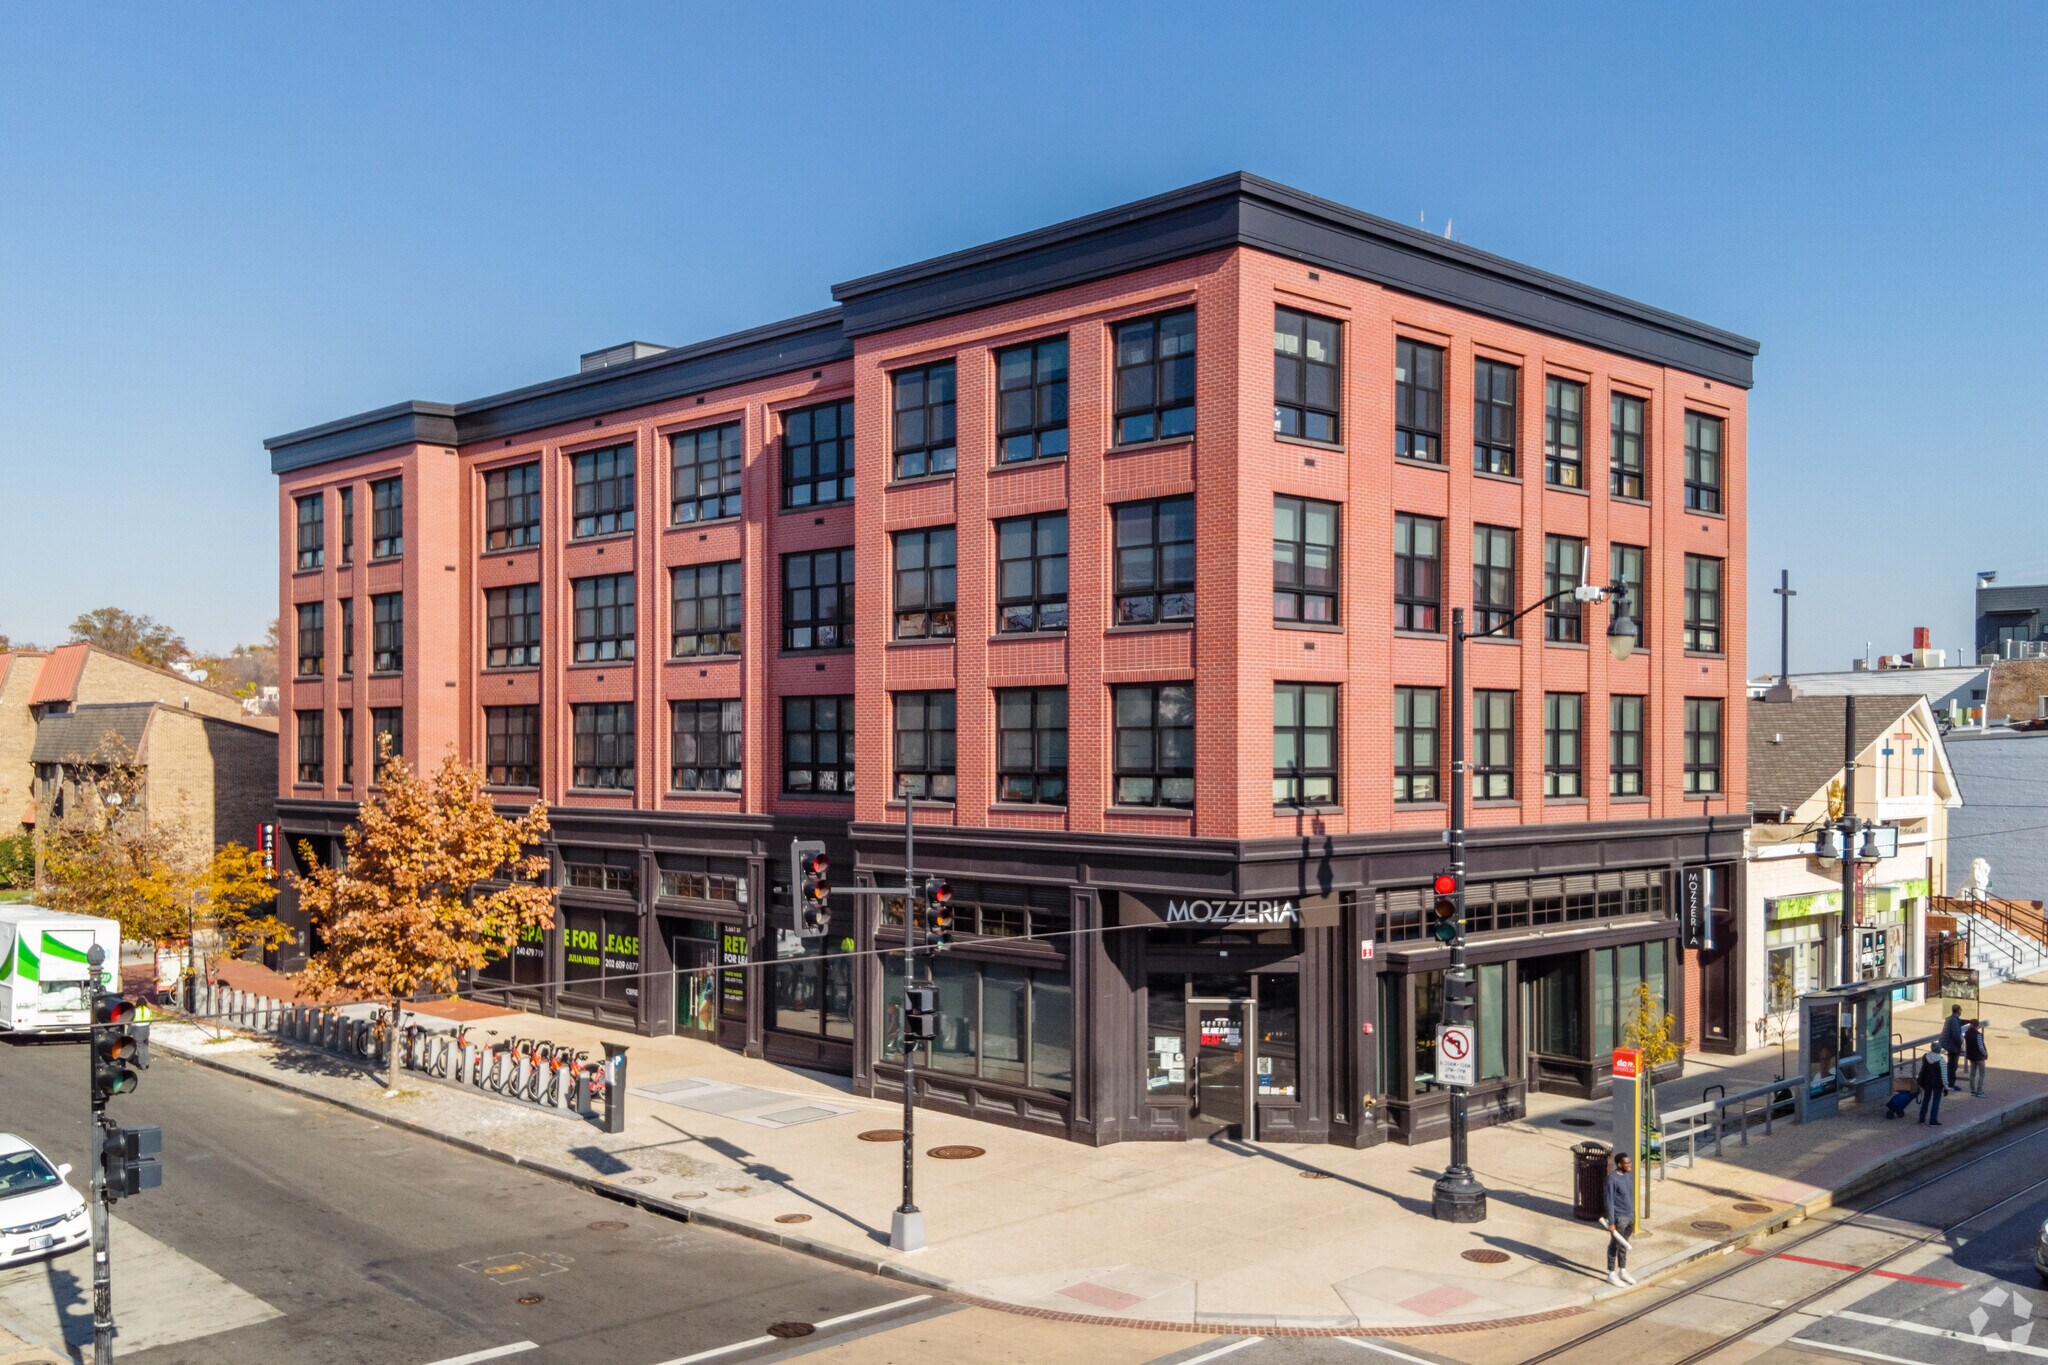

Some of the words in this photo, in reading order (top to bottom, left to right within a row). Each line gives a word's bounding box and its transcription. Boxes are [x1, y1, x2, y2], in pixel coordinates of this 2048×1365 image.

[1166, 899, 1298, 923] MOZZERIA
[1689, 873, 1698, 945] MOZZERIA
[572, 929, 598, 951] FOR
[605, 958, 615, 968] 202
[615, 960, 626, 970] 609
[724, 953, 737, 964] FOR
